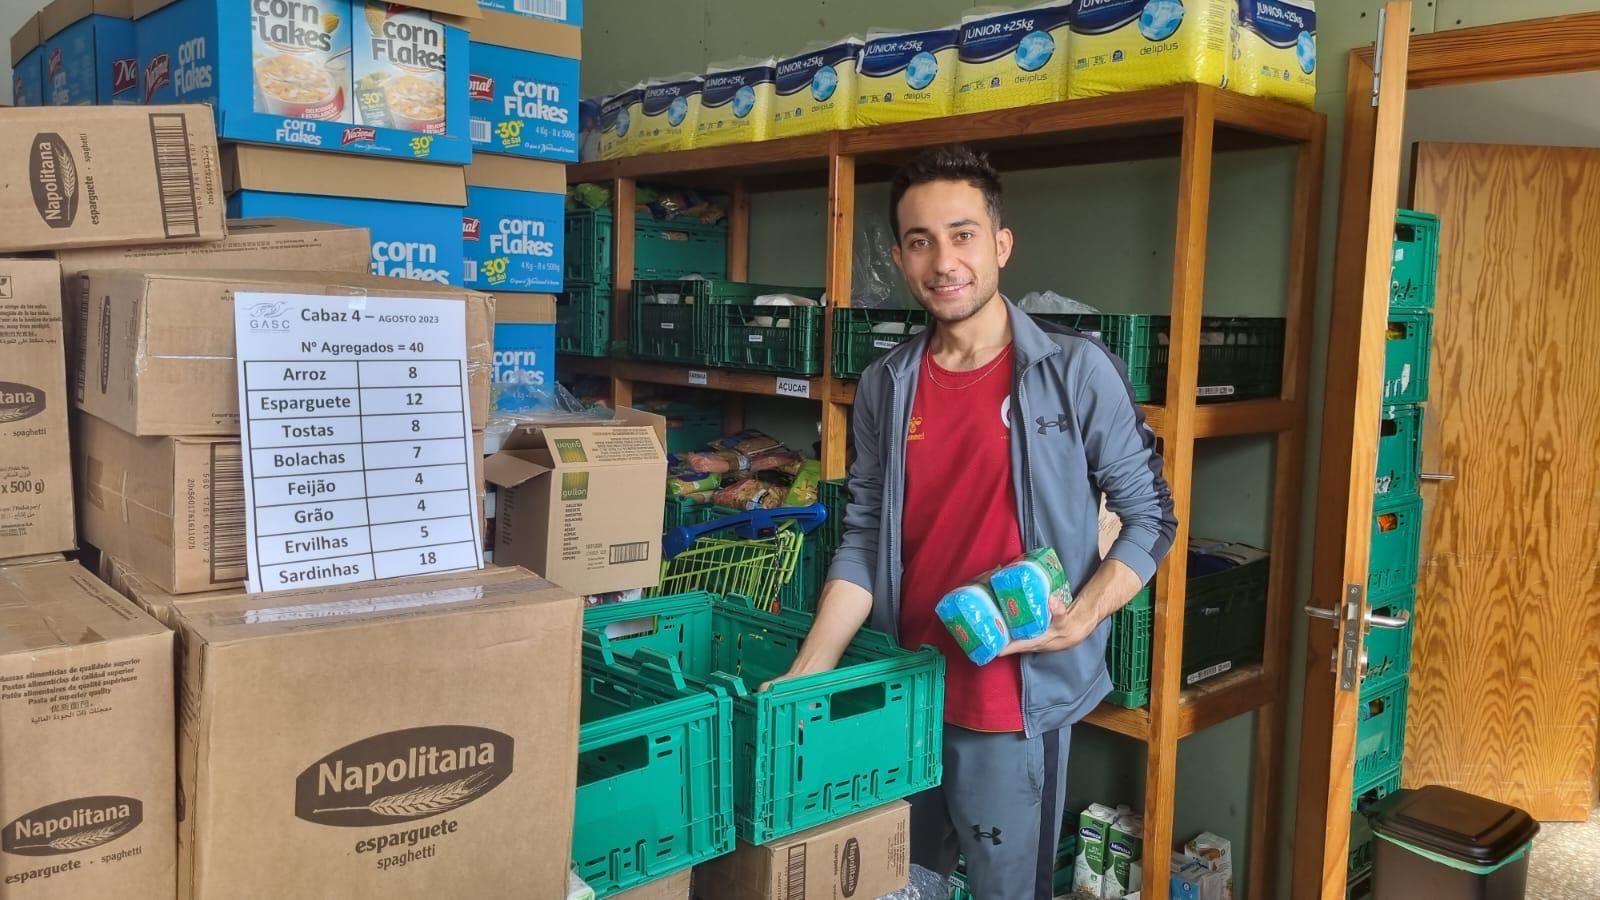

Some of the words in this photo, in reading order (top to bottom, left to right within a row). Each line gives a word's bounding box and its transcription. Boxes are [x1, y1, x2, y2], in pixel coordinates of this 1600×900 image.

[253, 0, 319, 25] corn
[382, 20, 438, 47] corn
[1003, 18, 1035, 31] +25kg
[178, 36, 205, 62] corn
[371, 38, 446, 71] Flakes
[898, 39, 924, 52] +25kg
[1140, 41, 1179, 56] deliplus
[174, 64, 212, 97] Flakes
[1014, 72, 1048, 85] deliplus
[513, 80, 560, 103] corn
[504, 95, 569, 125] Flakes
[283, 119, 316, 132] corn
[80, 133, 91, 163] spaghetti
[276, 129, 322, 146] Flakes
[39, 141, 63, 221] Napolitana
[88, 175, 101, 225] esparguete
[499, 218, 545, 237] corn
[372, 241, 437, 264] corn
[489, 234, 554, 258] Flakes
[300, 308, 348, 323] Cabaz
[351, 309, 361, 322] 4
[378, 314, 416, 324] AGOSTO
[418, 315, 440, 324] 2023
[301, 341, 317, 353] Nº
[321, 342, 394, 356] Agregados
[409, 341, 424, 354] 40
[493, 350, 536, 367] corn
[283, 368, 327, 382] Arroz
[408, 366, 418, 379] 8
[260, 396, 351, 412] Esparguete
[405, 393, 424, 406] 12
[12, 427, 47, 438] spaghetti
[281, 423, 334, 438] Tostas
[411, 419, 421, 432] 8
[273, 451, 346, 468] Bolachas
[412, 446, 422, 459] 7
[1, 484, 8, 494] x
[10, 480, 32, 493] 500
[35, 478, 45, 495] g)
[287, 479, 336, 498] Feijão
[414, 472, 424, 485] 4
[294, 508, 334, 524] Grão
[416, 499, 426, 512] 4
[284, 536, 349, 554] Ervilhas
[420, 525, 429, 538] 5
[279, 562, 360, 585] Sardinhas
[419, 551, 437, 566] 18
[79, 662, 112, 674] qualidade
[113, 658, 141, 668] superior
[107, 667, 135, 677] superior
[28, 697, 48, 705] Pasta
[59, 691, 87, 701] superior
[89, 687, 111, 698] quality
[318, 742, 495, 796] Napolitana
[15, 803, 131, 840] Napolitana
[355, 819, 458, 854] esparguete
[101, 845, 142, 865] spaghetti
[377, 844, 436, 871] spaghetti
[5, 859, 81, 886] esparguete
